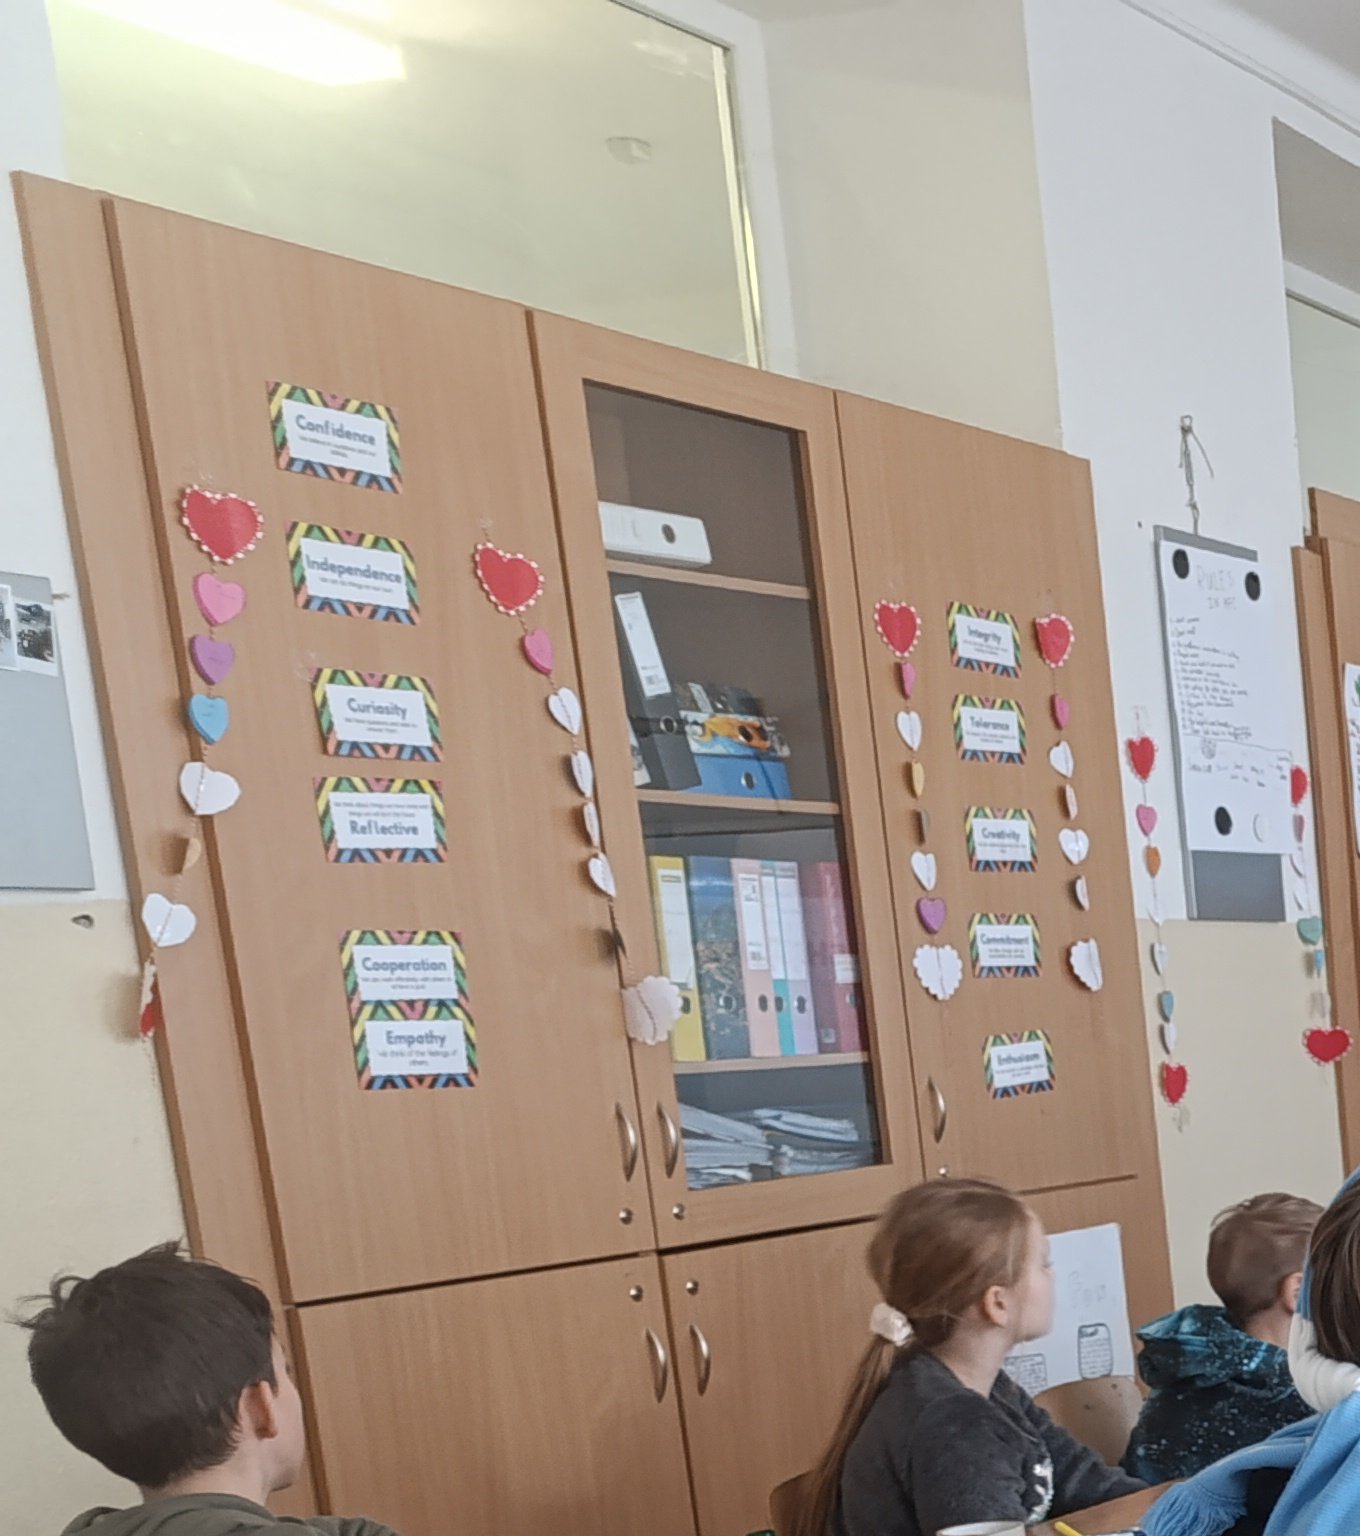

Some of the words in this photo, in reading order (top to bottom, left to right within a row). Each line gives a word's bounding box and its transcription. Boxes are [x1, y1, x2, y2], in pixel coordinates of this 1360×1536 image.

[296, 413, 376, 446] Confidence
[306, 554, 403, 584] Independence
[967, 625, 1002, 645] Integrity
[347, 697, 407, 721] Curiosity
[970, 716, 1010, 732] Tolerance
[349, 819, 419, 836] Reflective
[981, 827, 1021, 843] Creativity
[980, 933, 1029, 945] Commitment
[361, 957, 447, 975] Cooperation
[386, 1029, 447, 1048] Empathy
